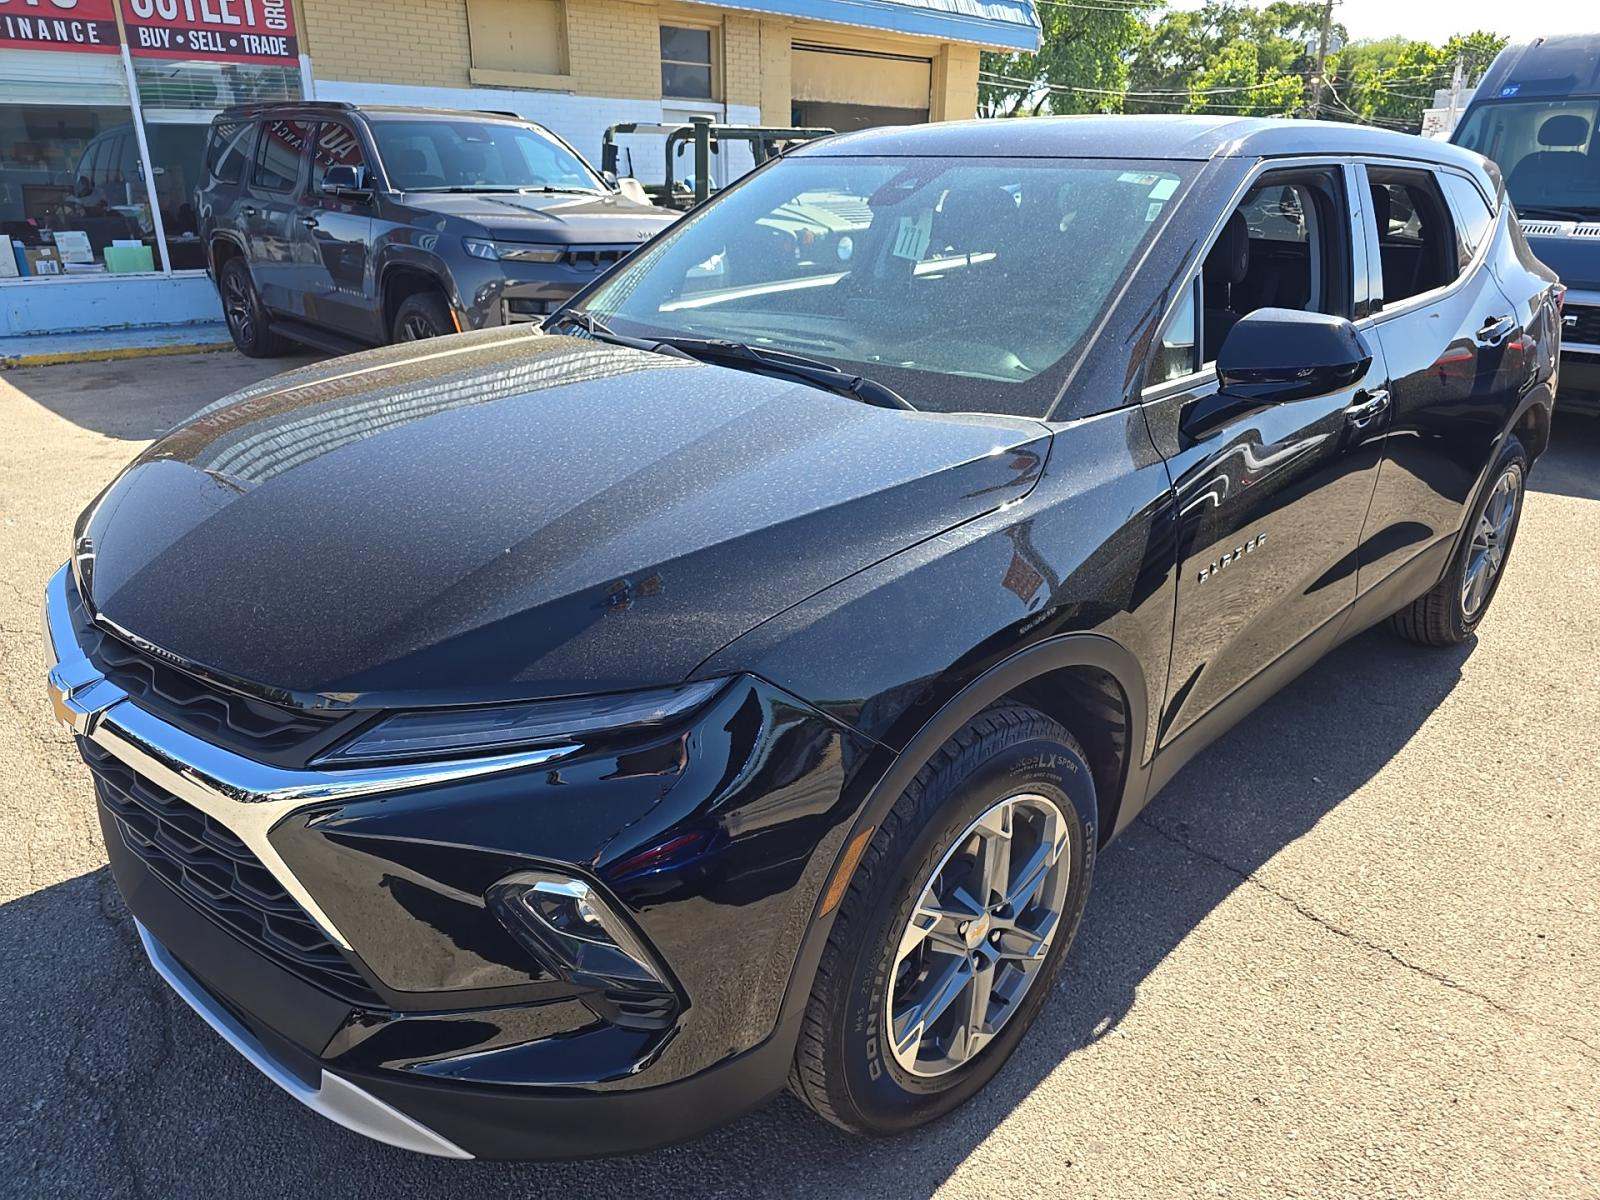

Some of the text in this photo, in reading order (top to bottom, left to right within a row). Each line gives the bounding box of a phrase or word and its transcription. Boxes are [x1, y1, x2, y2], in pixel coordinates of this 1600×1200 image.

[0, 16, 100, 43] INANCE
[138, 27, 289, 56] BUY SELL TRADE
[1198, 532, 1267, 585] BLAZER
